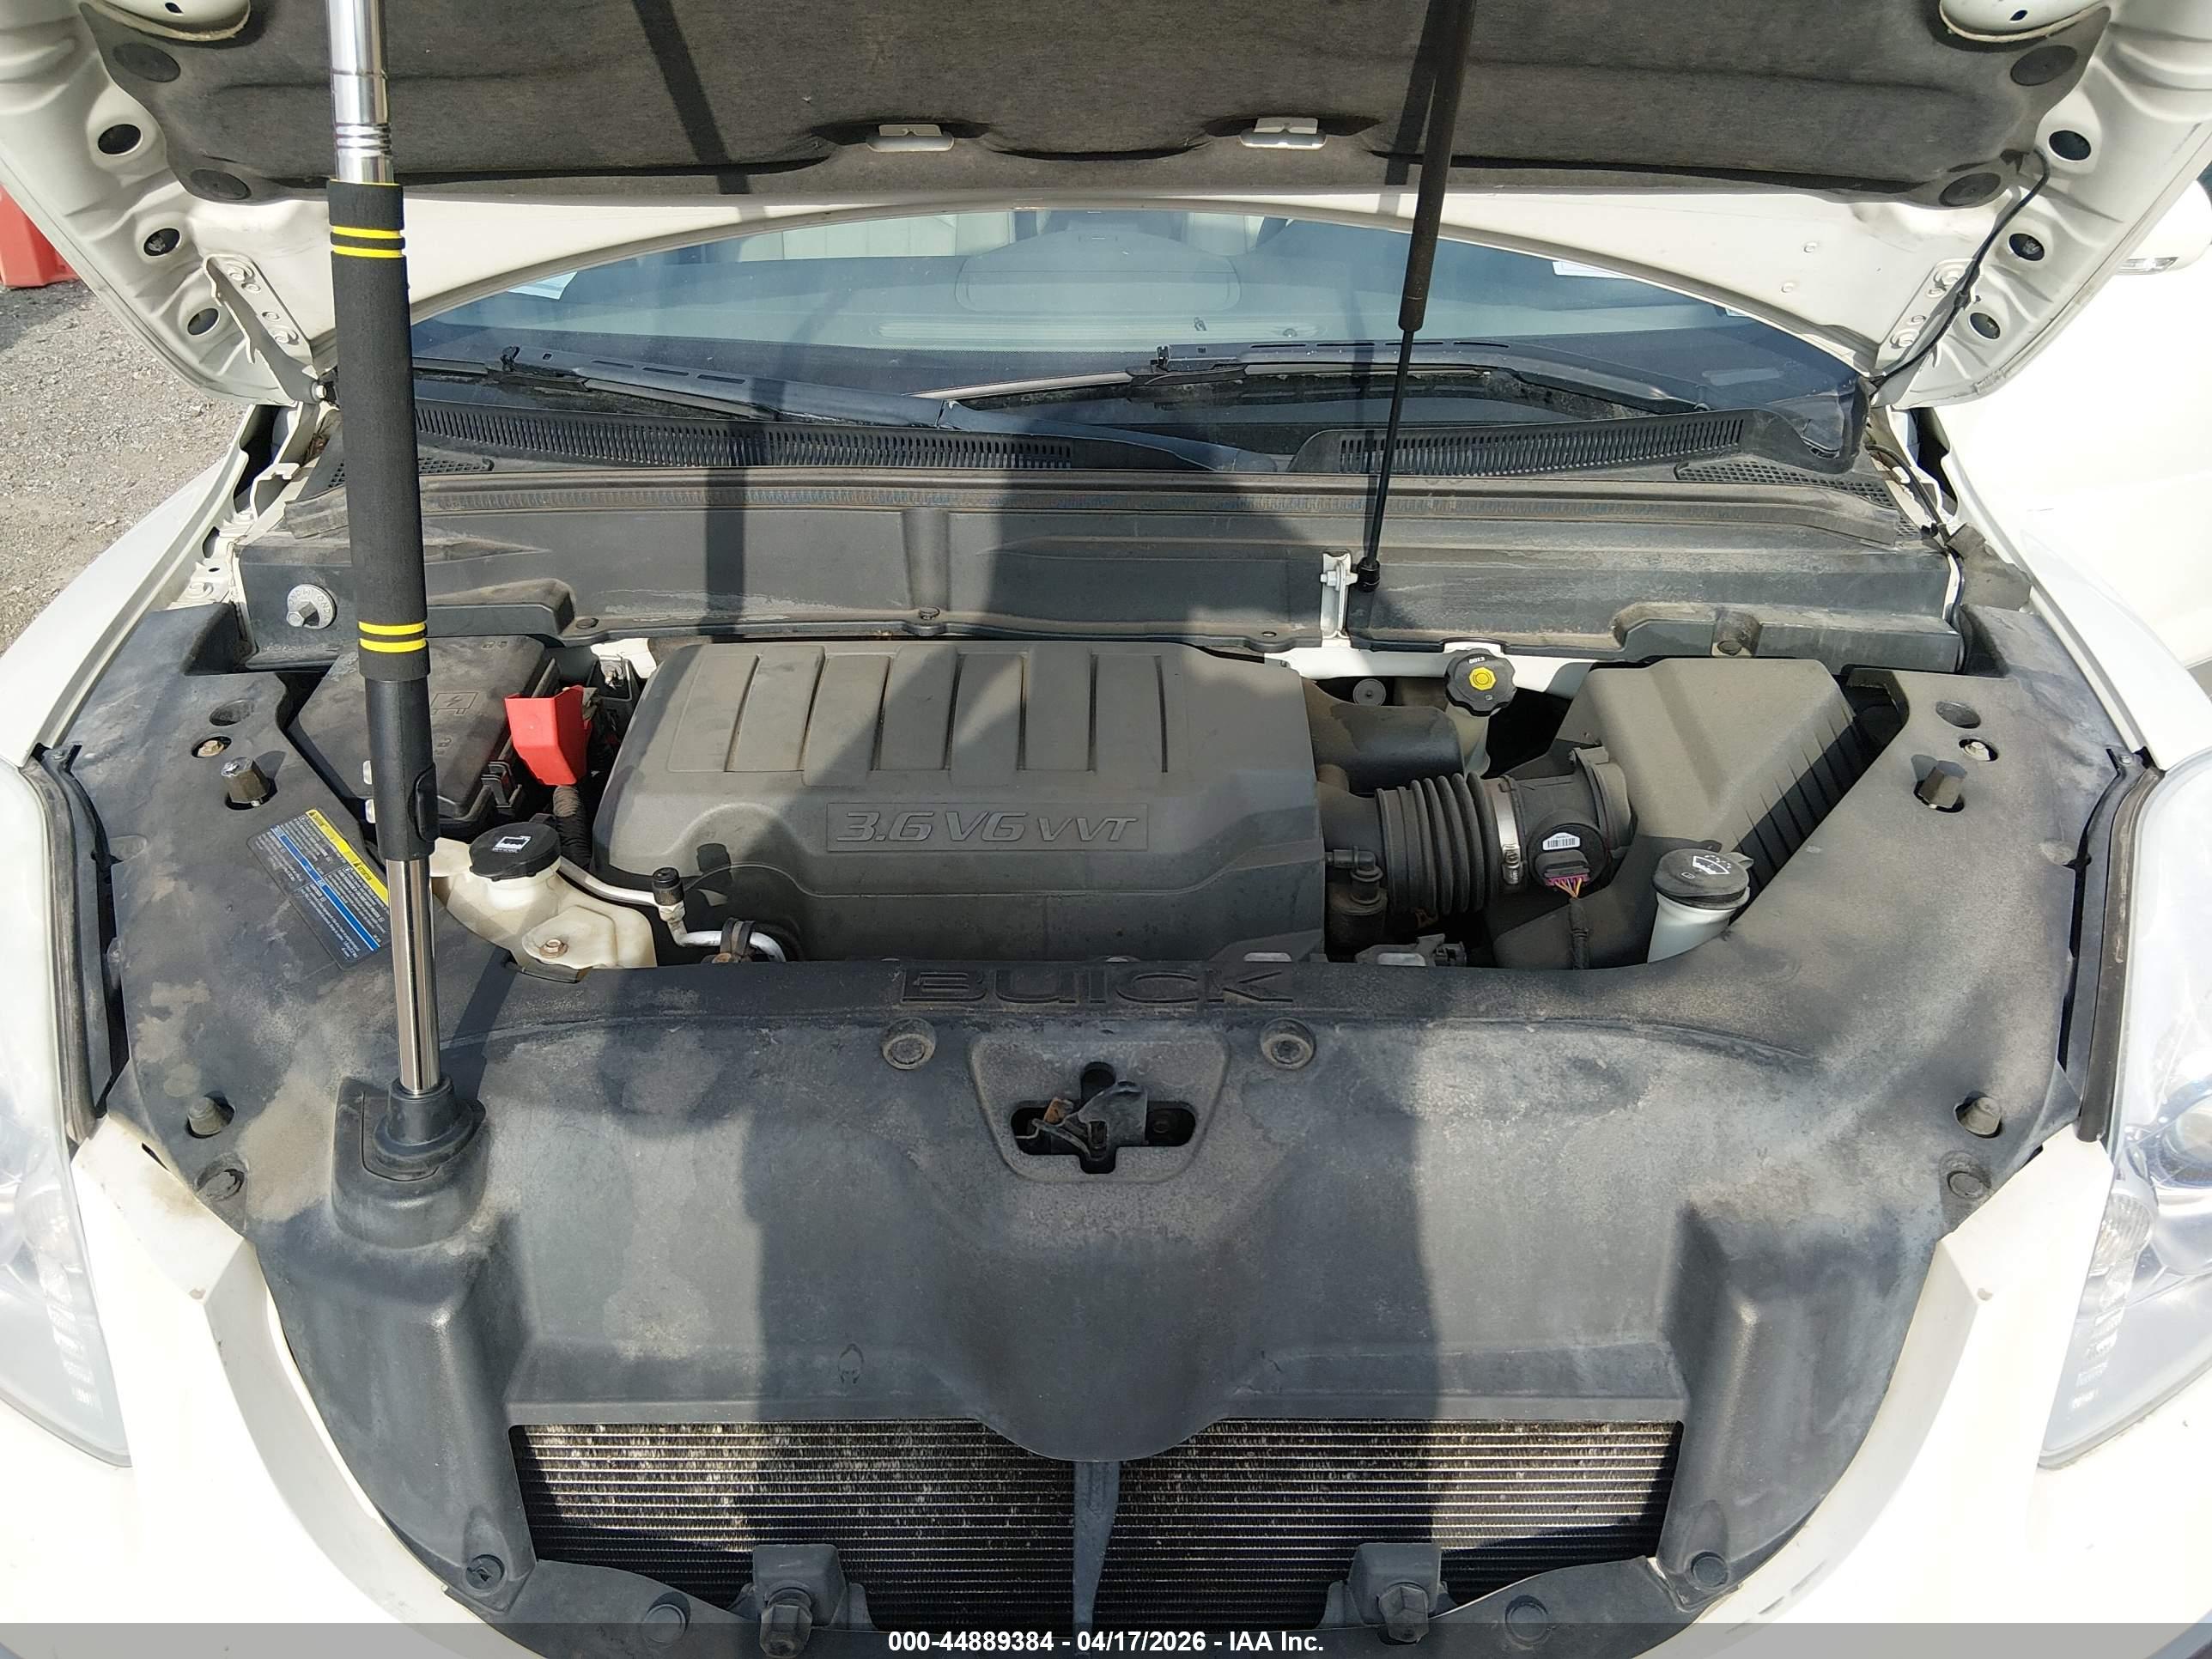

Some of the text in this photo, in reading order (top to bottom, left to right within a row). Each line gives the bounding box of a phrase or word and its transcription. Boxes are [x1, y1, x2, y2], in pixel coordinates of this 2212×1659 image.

[836, 811, 1139, 842] 3.6 V6 VVT
[900, 967, 1294, 1005] BUICK
